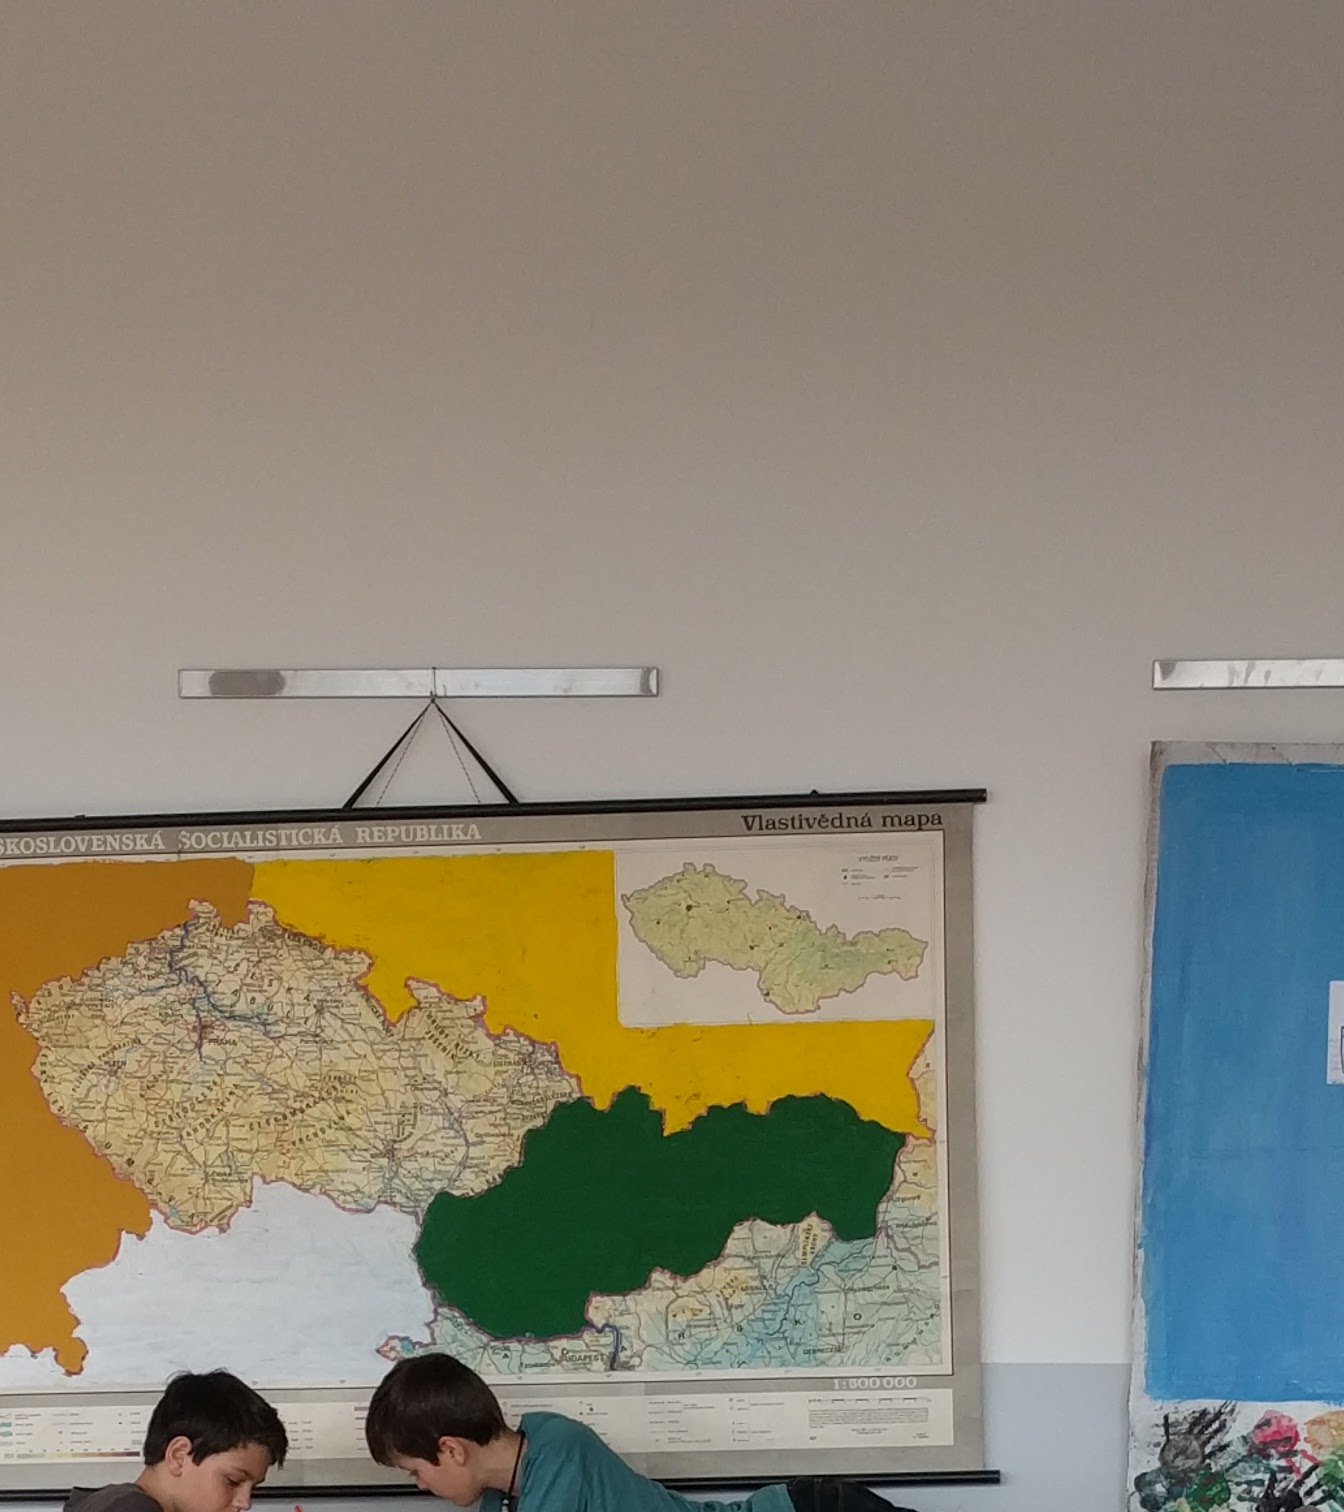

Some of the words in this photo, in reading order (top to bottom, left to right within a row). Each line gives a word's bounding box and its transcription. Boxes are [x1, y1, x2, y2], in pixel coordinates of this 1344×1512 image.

[741, 811, 873, 832] Vlastivědná
[881, 813, 944, 831] mapa
[178, 824, 344, 852] SOCIALISTICKÁ
[356, 823, 483, 844] REPUBLIKA
